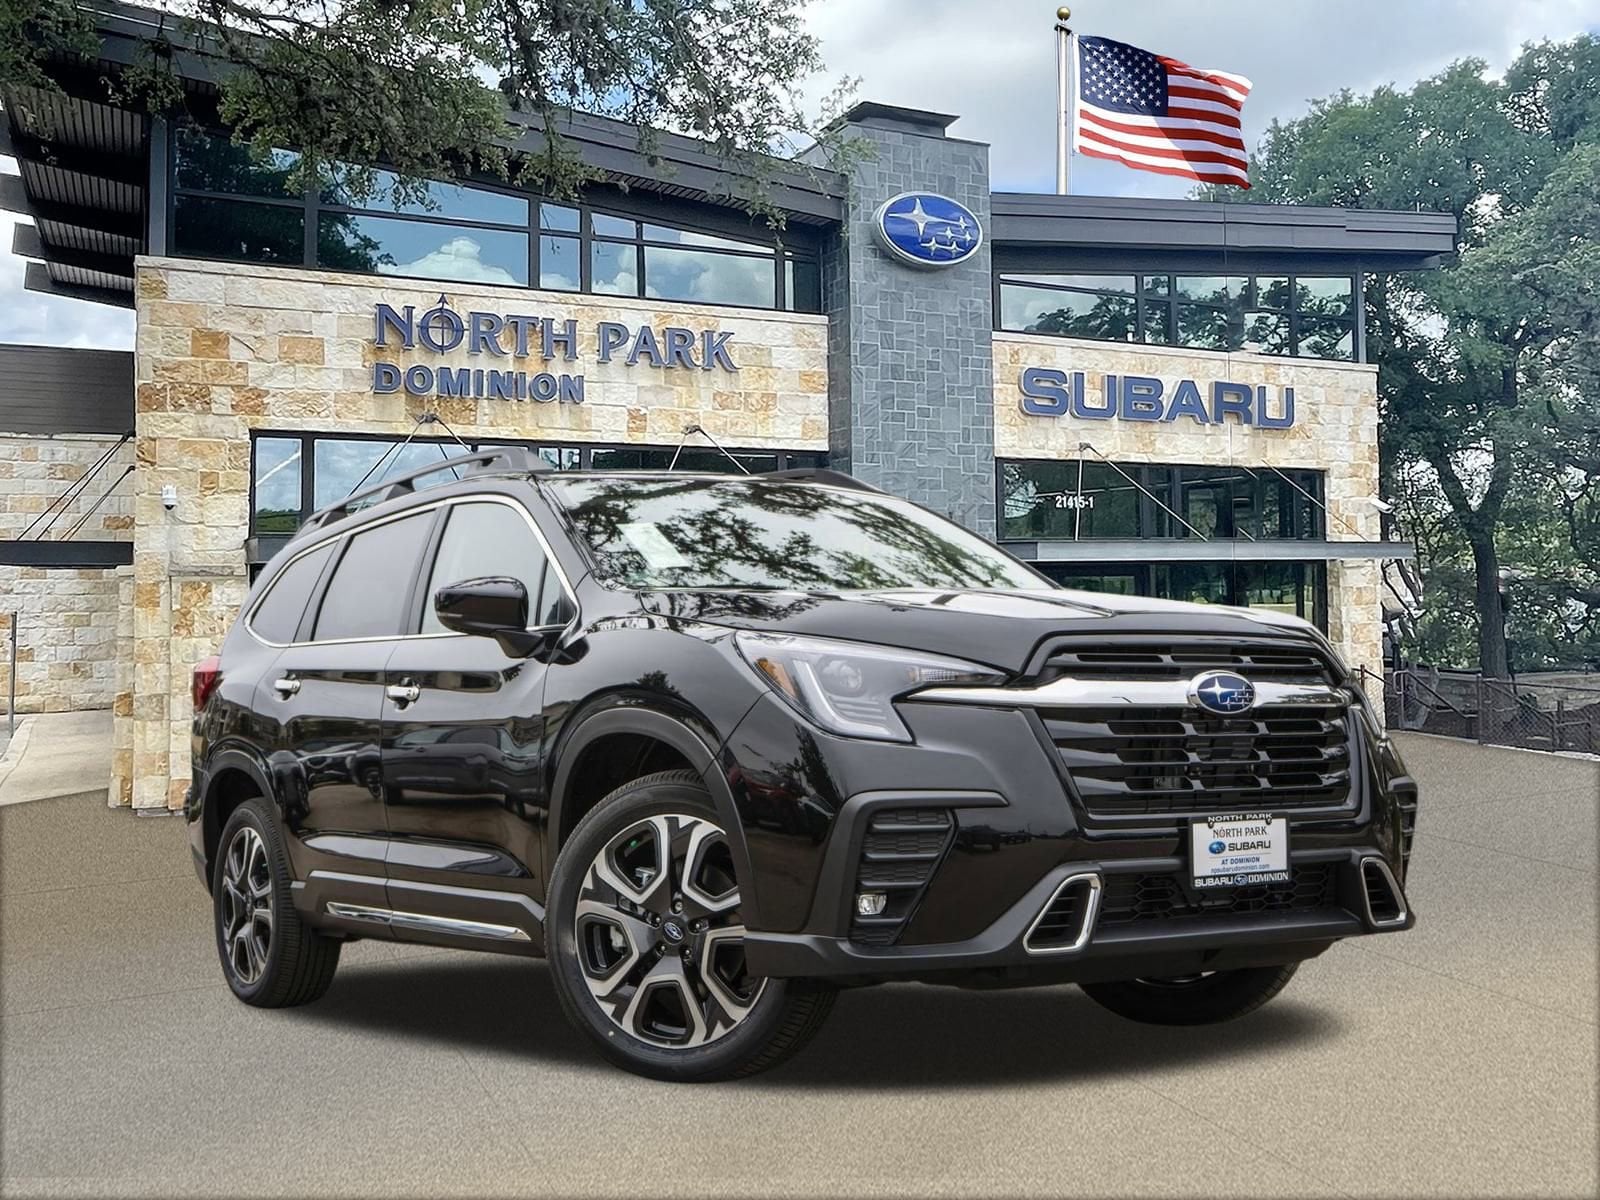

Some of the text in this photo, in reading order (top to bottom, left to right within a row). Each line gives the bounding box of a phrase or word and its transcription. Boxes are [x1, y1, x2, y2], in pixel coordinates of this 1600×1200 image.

[374, 299, 742, 373] NORTH PARK
[373, 362, 585, 405] DOMINION
[1018, 366, 1295, 430] SUBARU
[1213, 827, 1267, 838] NORTH PARK
[1228, 840, 1271, 851] SUBARU
[1194, 872, 1289, 887] SUBARU DOMINION
